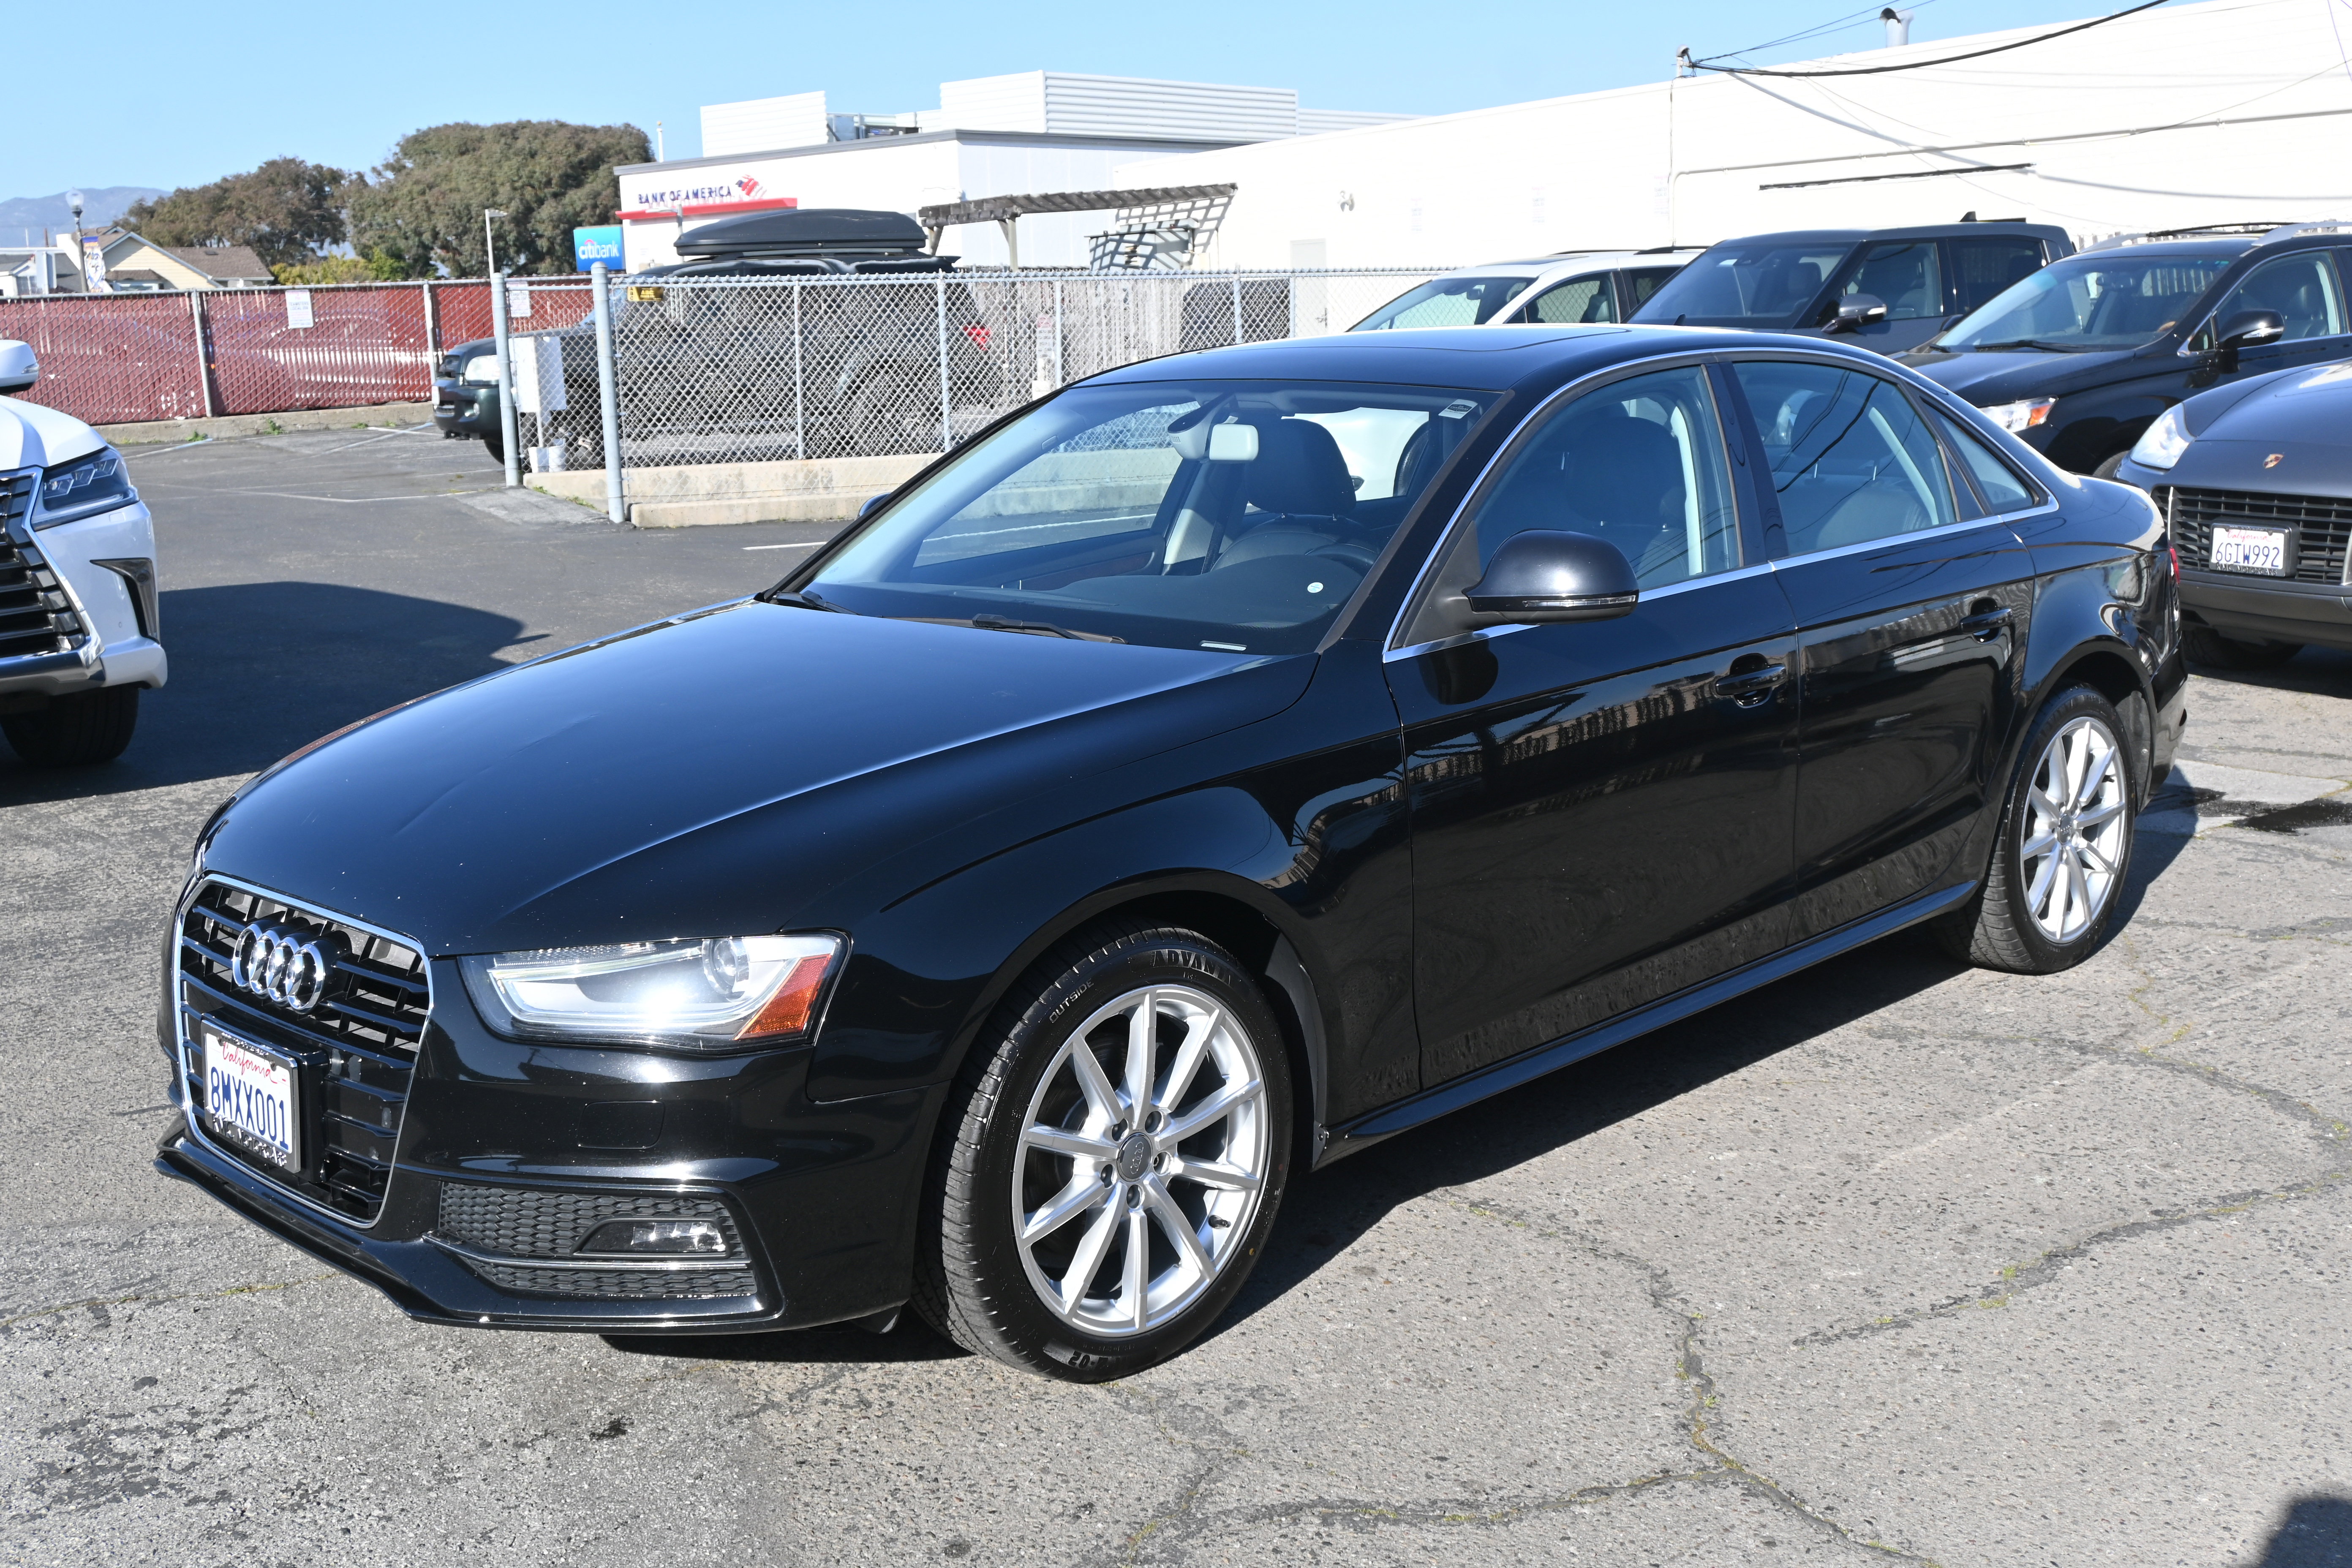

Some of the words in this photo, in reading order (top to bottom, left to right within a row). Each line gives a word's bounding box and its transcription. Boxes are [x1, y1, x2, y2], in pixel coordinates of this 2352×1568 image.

[638, 192, 666, 204] BANK
[669, 190, 681, 201] OF
[684, 185, 732, 200] AMERICA
[578, 240, 620, 260] citibank
[2227, 529, 2272, 542] California
[2216, 542, 2280, 568] 6GIW992
[2237, 565, 2278, 577] MOTORCARS
[1049, 978, 1094, 1023] OUTSIDE
[223, 1041, 278, 1084] California
[211, 1066, 289, 1151] 8MXX001
